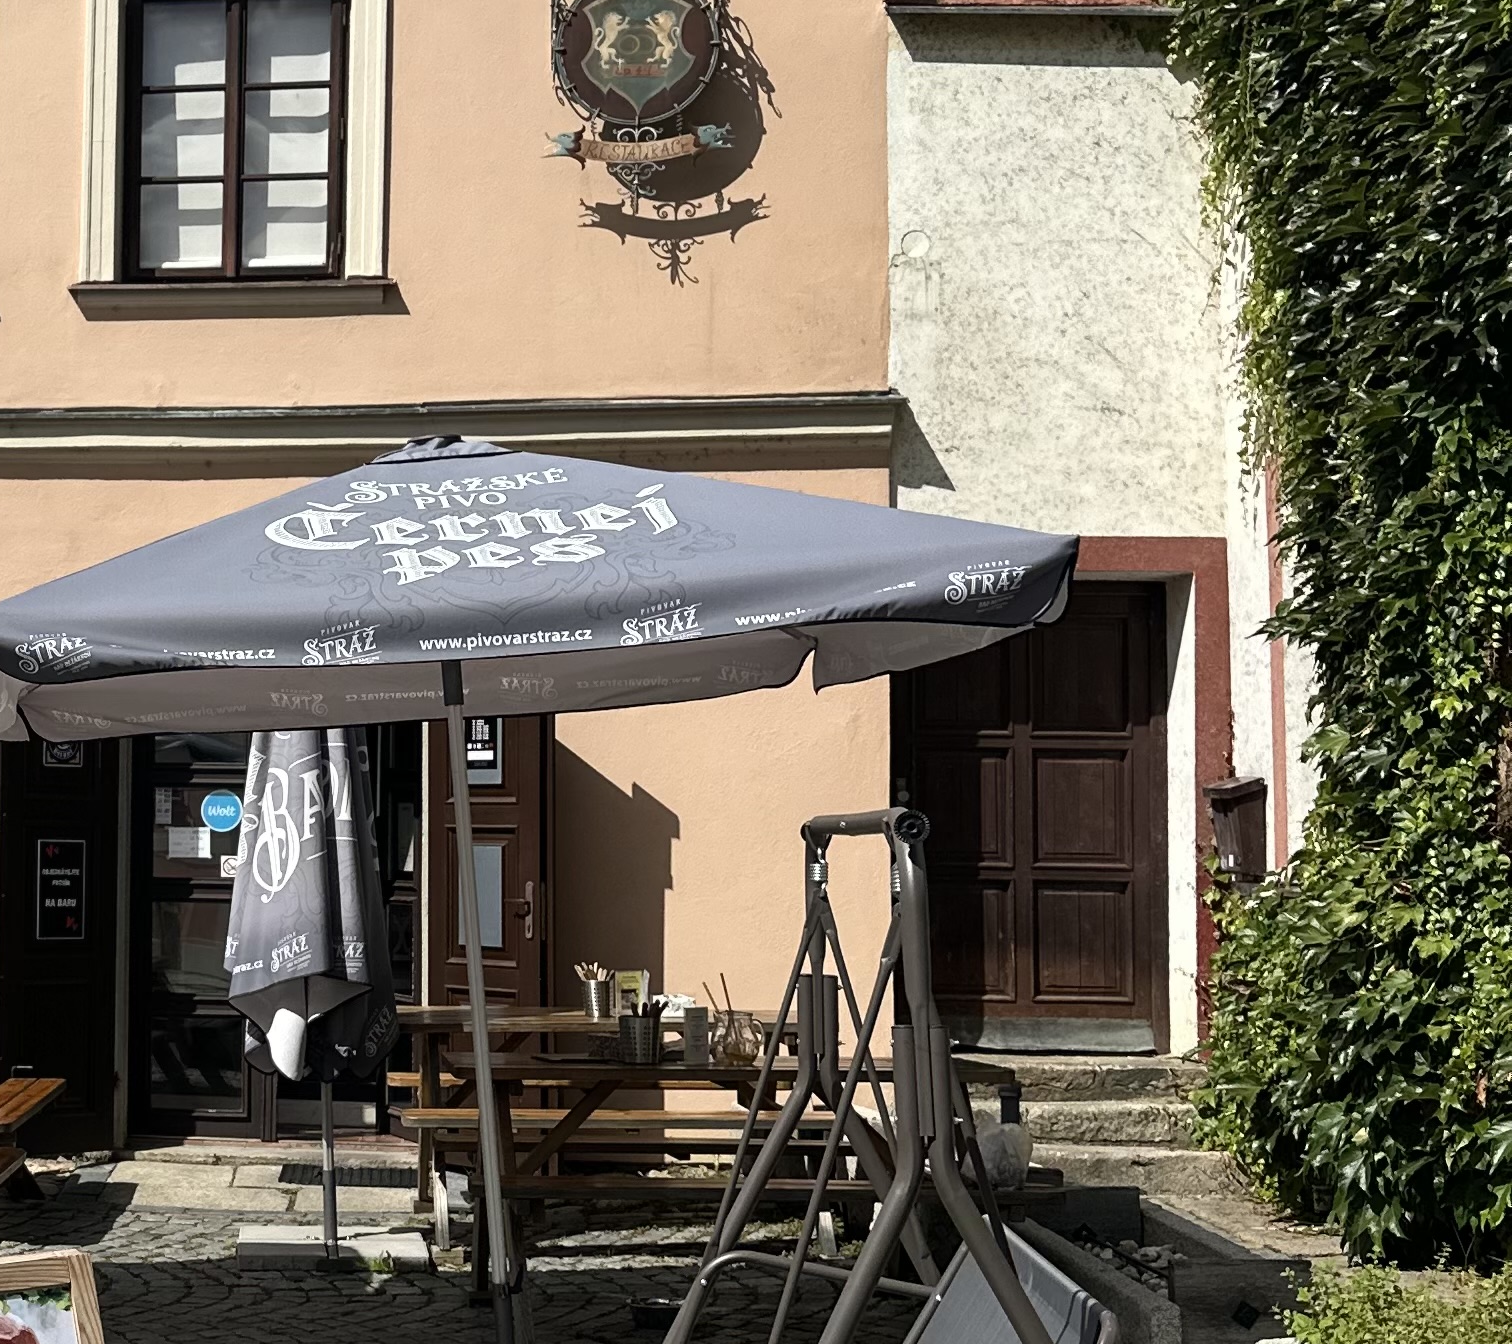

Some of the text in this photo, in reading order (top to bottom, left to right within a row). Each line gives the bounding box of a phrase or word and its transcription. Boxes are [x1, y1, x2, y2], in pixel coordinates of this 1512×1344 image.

[582, 139, 689, 160] RESTAURACE
[414, 491, 508, 510] PIVO
[264, 483, 679, 551] Černej
[383, 533, 607, 585] pes
[320, 620, 360, 635] PIVOVAR
[420, 629, 592, 651] www.pivovarstraz.cz
[208, 805, 236, 817] Wolt
